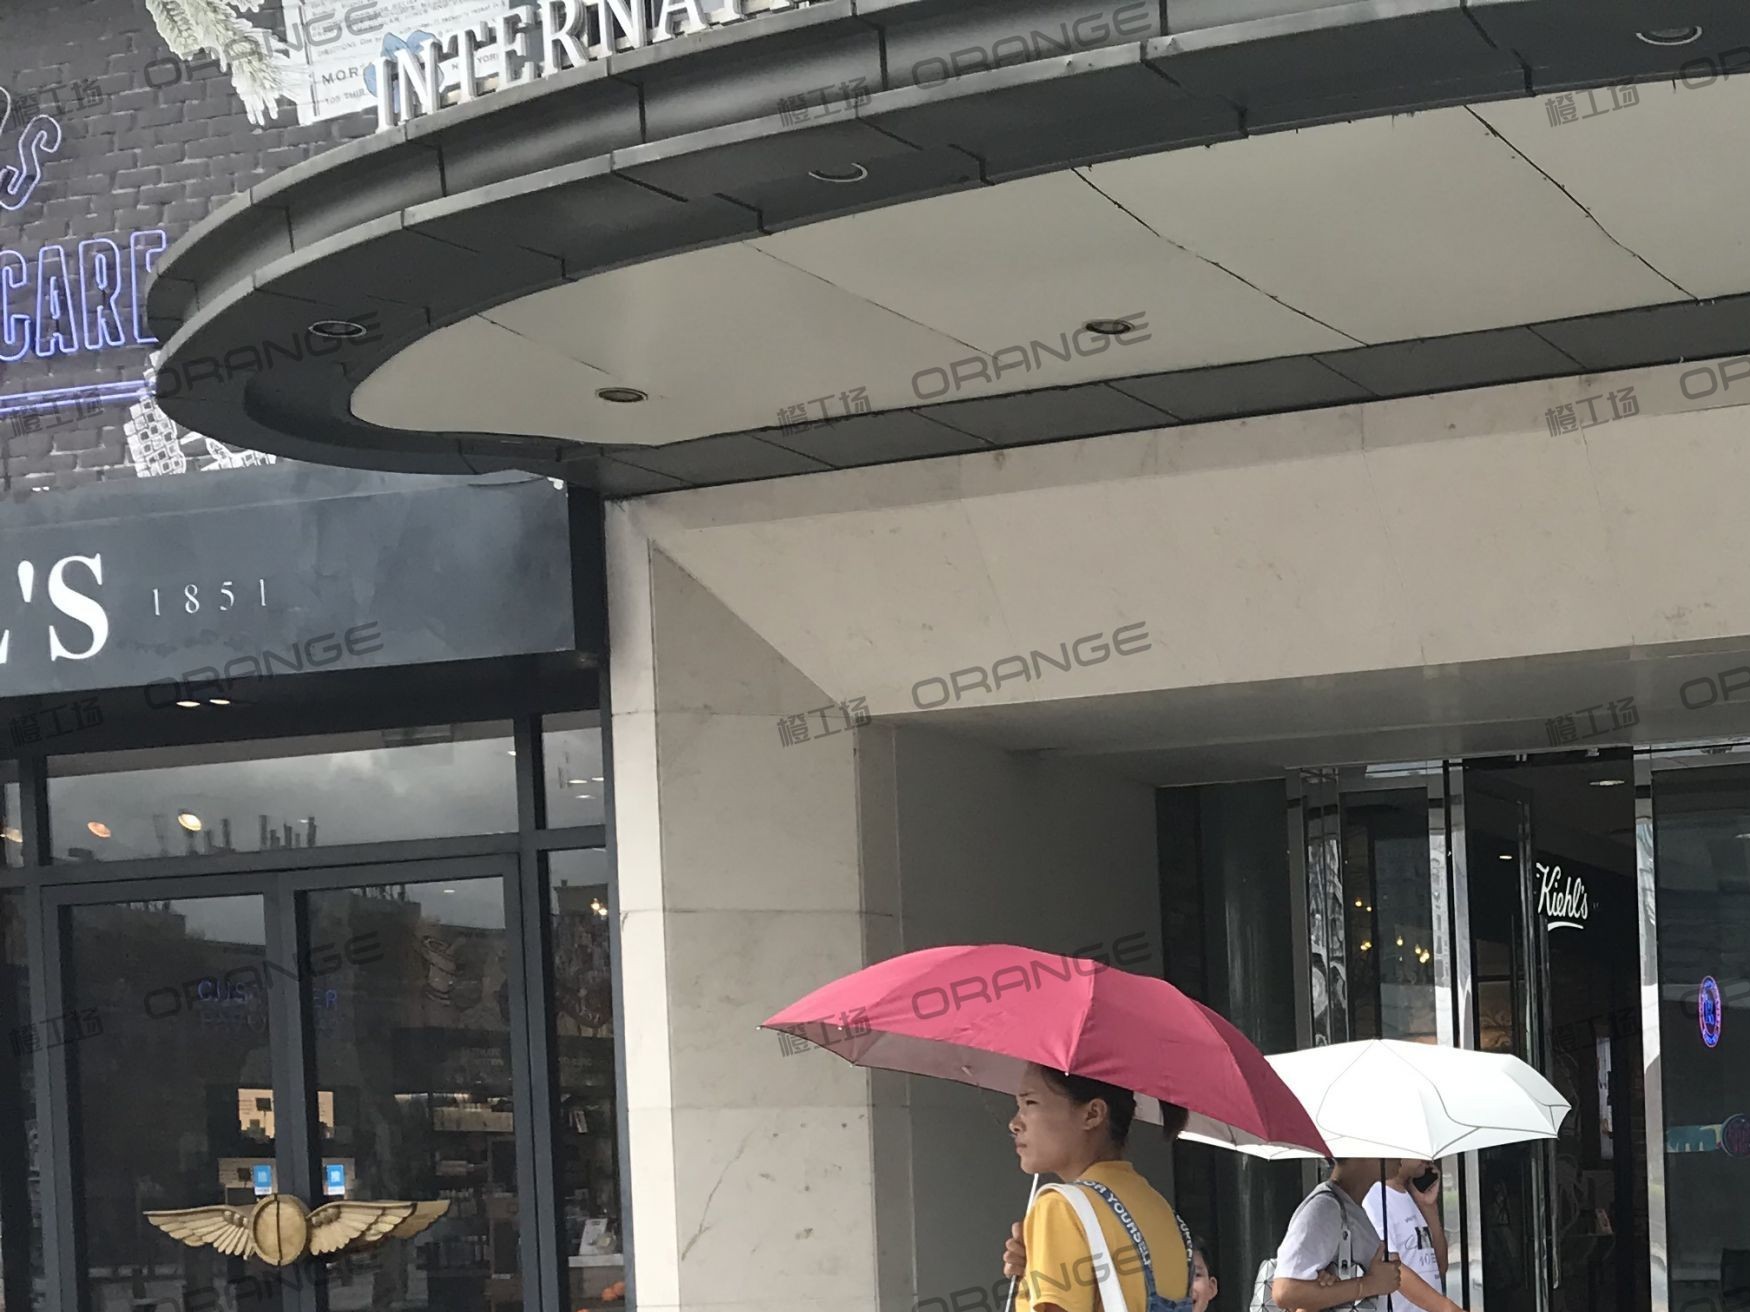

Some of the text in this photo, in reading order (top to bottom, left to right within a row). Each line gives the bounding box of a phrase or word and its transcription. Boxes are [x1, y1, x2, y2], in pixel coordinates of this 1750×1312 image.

[0, 553, 267, 664] 'S 1851
[1535, 862, 1589, 920] Kiehl's
